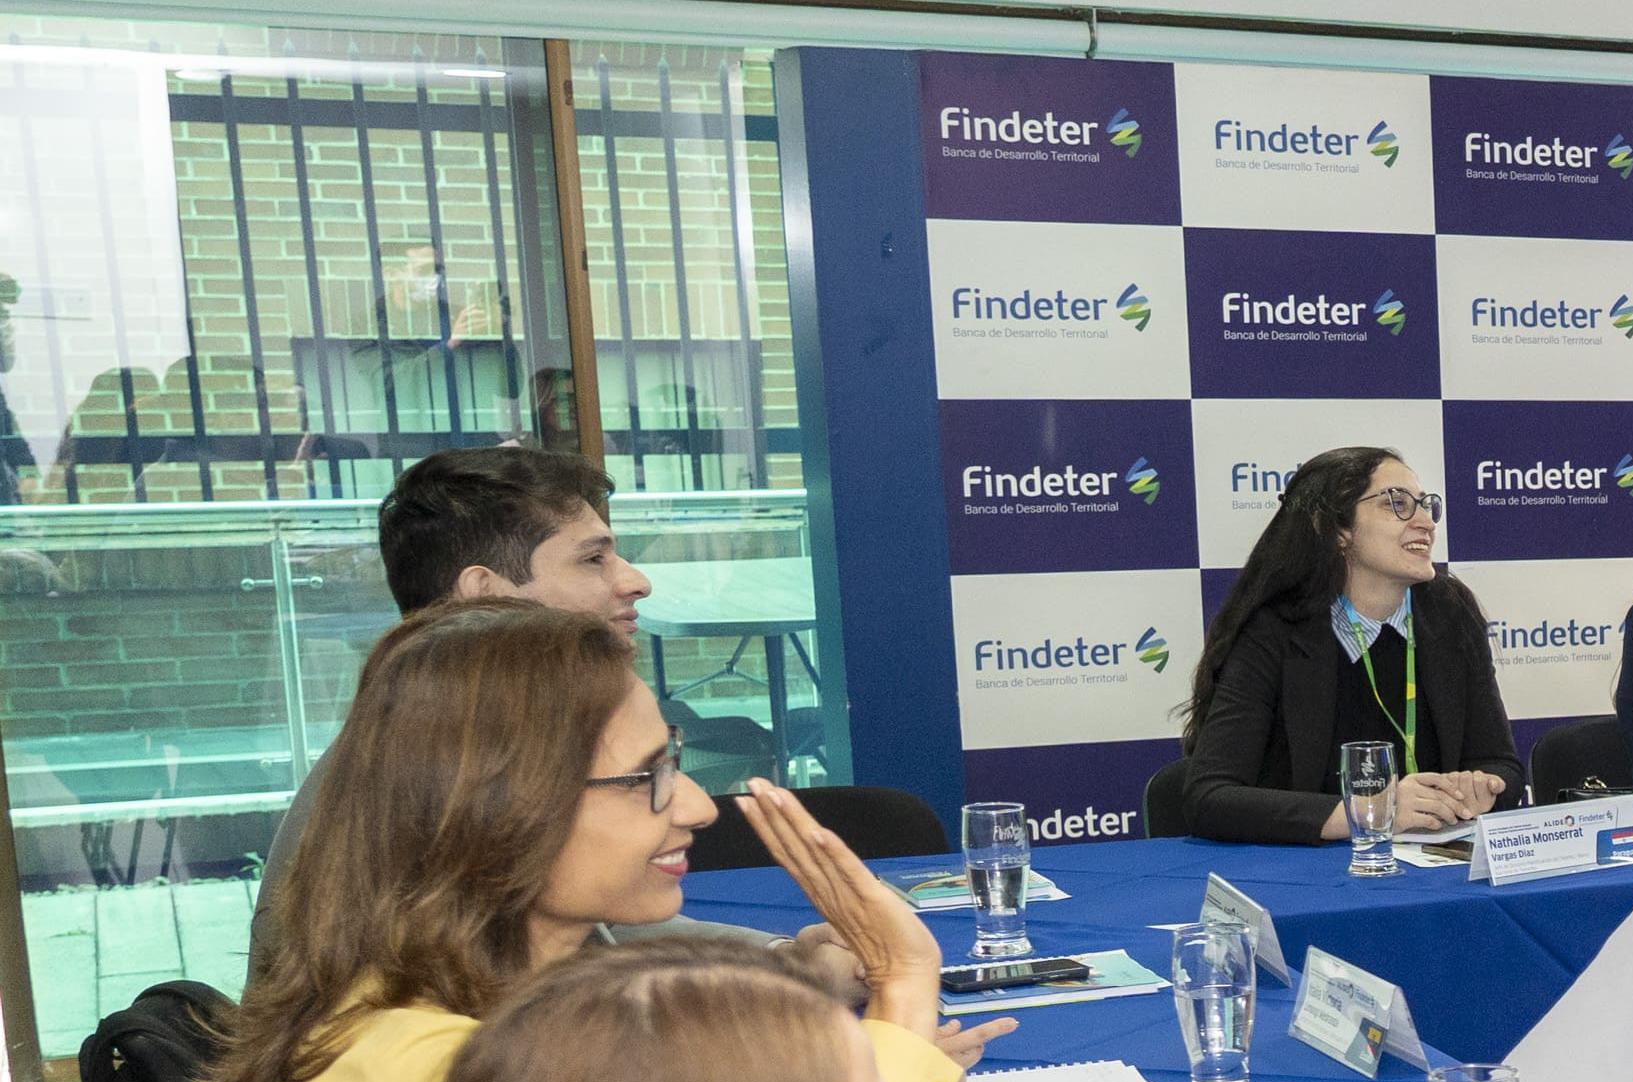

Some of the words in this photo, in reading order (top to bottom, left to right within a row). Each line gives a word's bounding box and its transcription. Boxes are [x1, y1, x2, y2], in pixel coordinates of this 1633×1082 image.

[941, 107, 1098, 145] Findeter
[1216, 119, 1358, 155] Findeter
[942, 147, 976, 160] Banca
[979, 148, 992, 160] de
[995, 149, 1048, 162] Desarrollo
[1051, 151, 1100, 163] Territorial
[1465, 133, 1597, 168] Findeter
[1216, 158, 1247, 169] Banca
[1250, 159, 1261, 169] de
[1264, 160, 1312, 172] Desarrollo
[1315, 162, 1359, 173] Territorial
[1466, 169, 1494, 180] Banca
[1497, 170, 1508, 180] de
[1510, 171, 1555, 182] Desarrollo
[1558, 172, 1599, 184] Territorial
[953, 288, 1107, 321] Findeter
[1223, 293, 1366, 325] Findeter
[1472, 297, 1602, 328] Findeter
[953, 327, 986, 338] Banca
[989, 327, 1001, 338] de
[1004, 327, 1057, 339] Desarrollo
[1060, 327, 1108, 339] Territorial
[1224, 330, 1255, 341] Banca
[1258, 330, 1269, 341] de
[1271, 330, 1320, 341] Desarrollo
[1323, 330, 1367, 341] Territorial
[1472, 334, 1500, 344] Banca
[1515, 334, 1560, 345] Desarrollo
[1562, 334, 1602, 345] Territorial
[963, 466, 1117, 498] Findeter
[1477, 460, 1607, 490] Findeter
[1232, 500, 1262, 510] Banca
[1478, 494, 1506, 505] Banca
[1508, 494, 1519, 505] de
[1522, 494, 1565, 505] Desarrollo
[1568, 493, 1608, 504] Territorial
[964, 504, 997, 515] Banca
[1000, 503, 1013, 514] de
[1016, 502, 1068, 513] Desarrollo
[1071, 501, 1118, 512] Territorial
[976, 637, 1127, 670] Findeter
[1526, 654, 1568, 665] Desarrollo
[1572, 652, 1612, 663] Territorial
[976, 677, 1008, 689] Banca
[1011, 676, 1024, 688] de
[1026, 675, 1078, 687] Desarrollo
[1081, 673, 1127, 685] Territorial
[1027, 805, 1136, 841] ndeter
[1579, 813, 1605, 823] Findeter
[1489, 834, 1531, 850] Nathalia
[1533, 827, 1583, 844] Monserrat
[1491, 850, 1517, 862] Vargas
